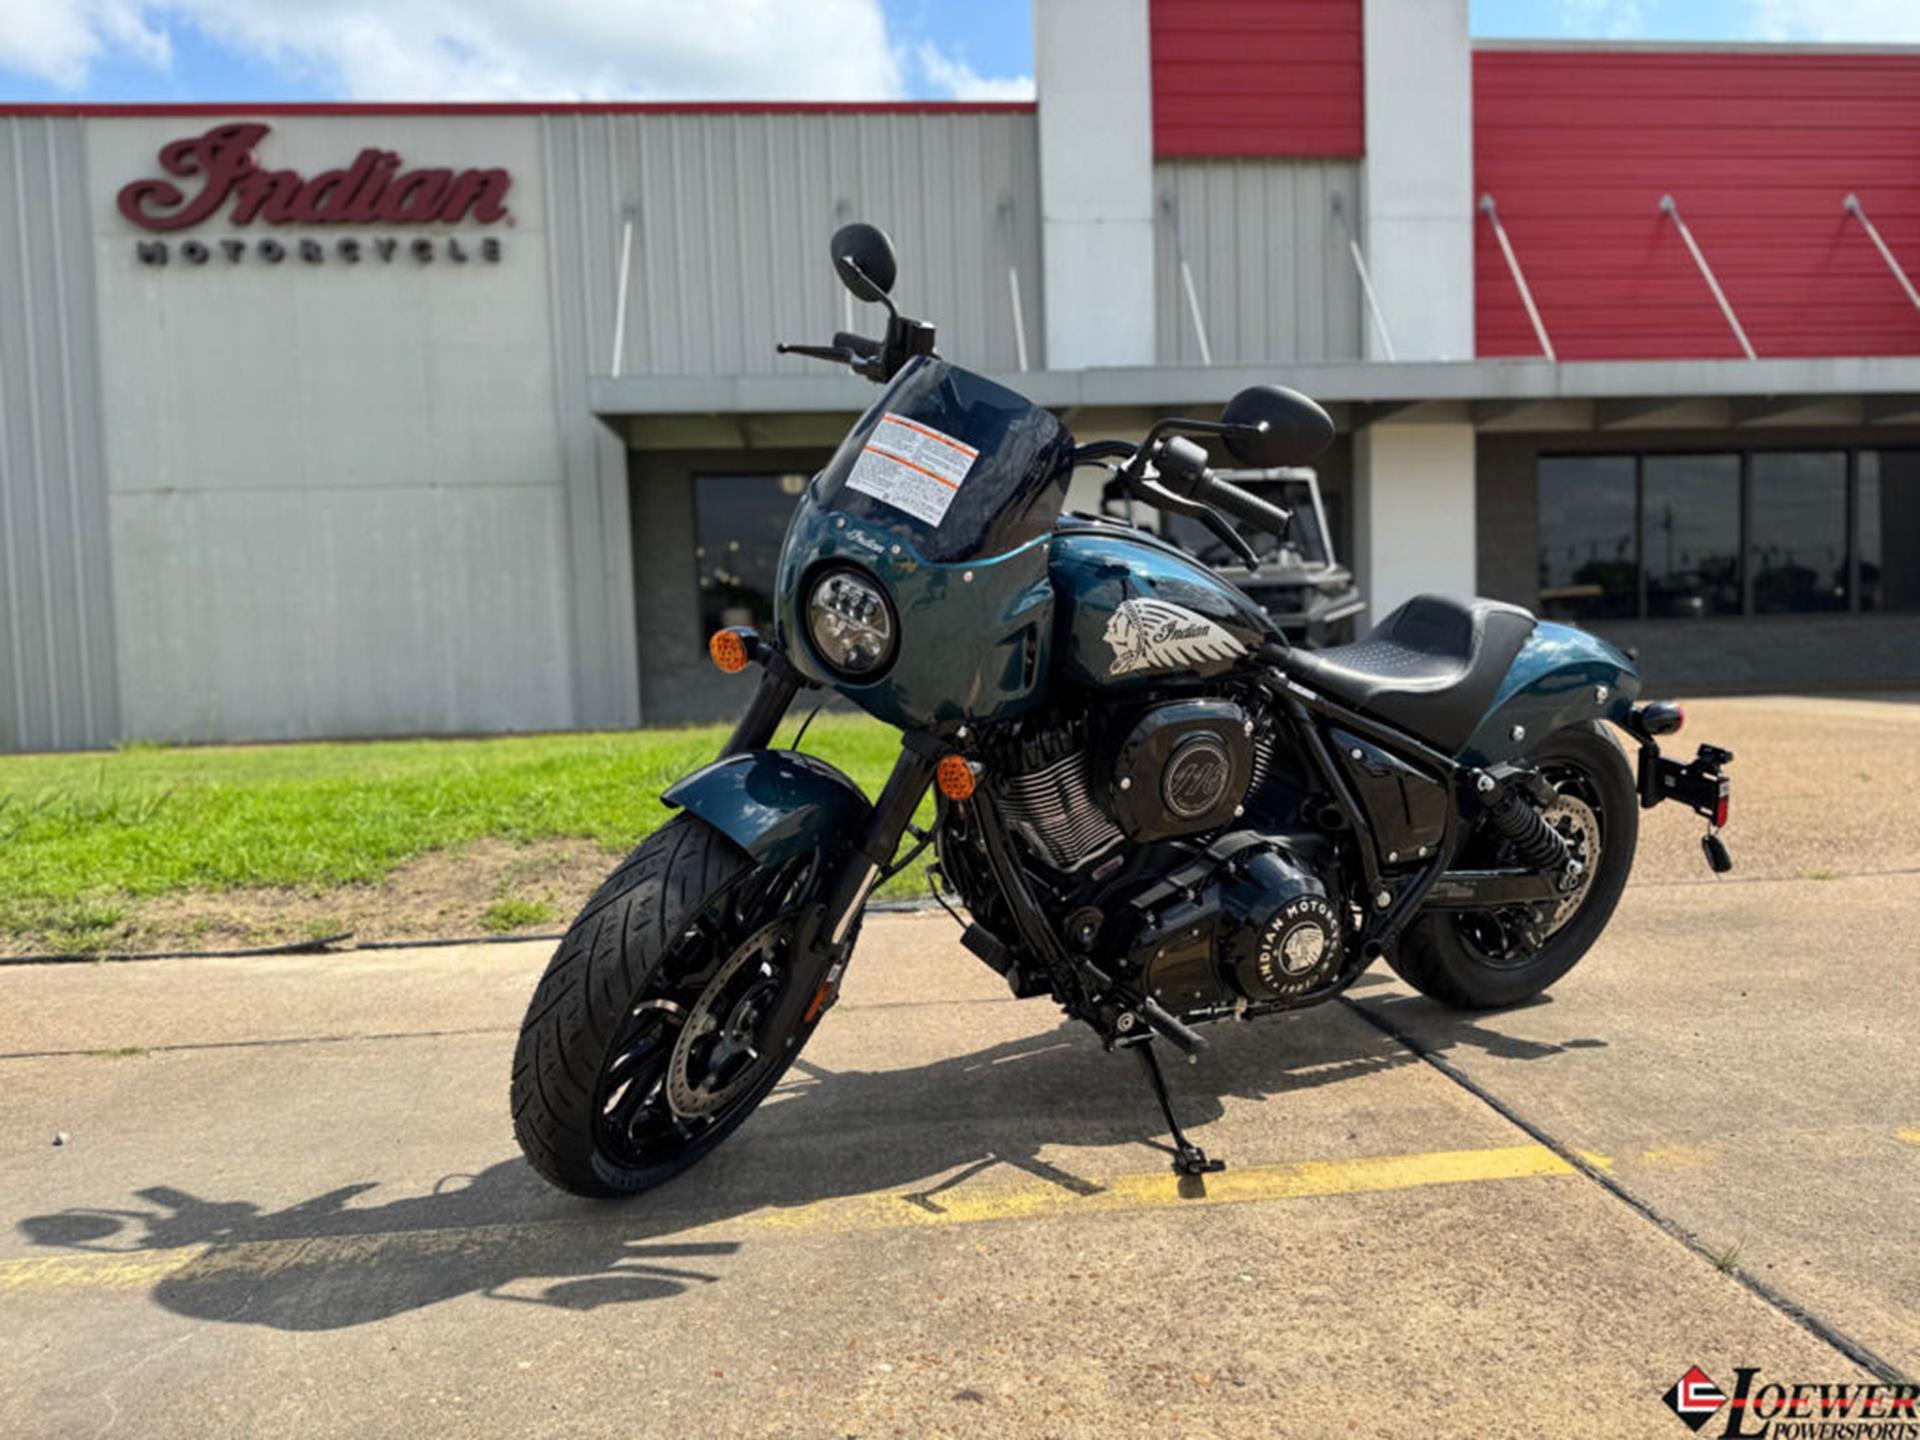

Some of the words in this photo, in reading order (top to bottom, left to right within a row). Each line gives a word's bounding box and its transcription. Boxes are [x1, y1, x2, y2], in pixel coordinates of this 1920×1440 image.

[117, 122, 512, 232] Indian
[137, 239, 503, 265] MOTORCYCLE
[1153, 620, 1211, 643] Indian
[1260, 918, 1284, 982] INDIAN
